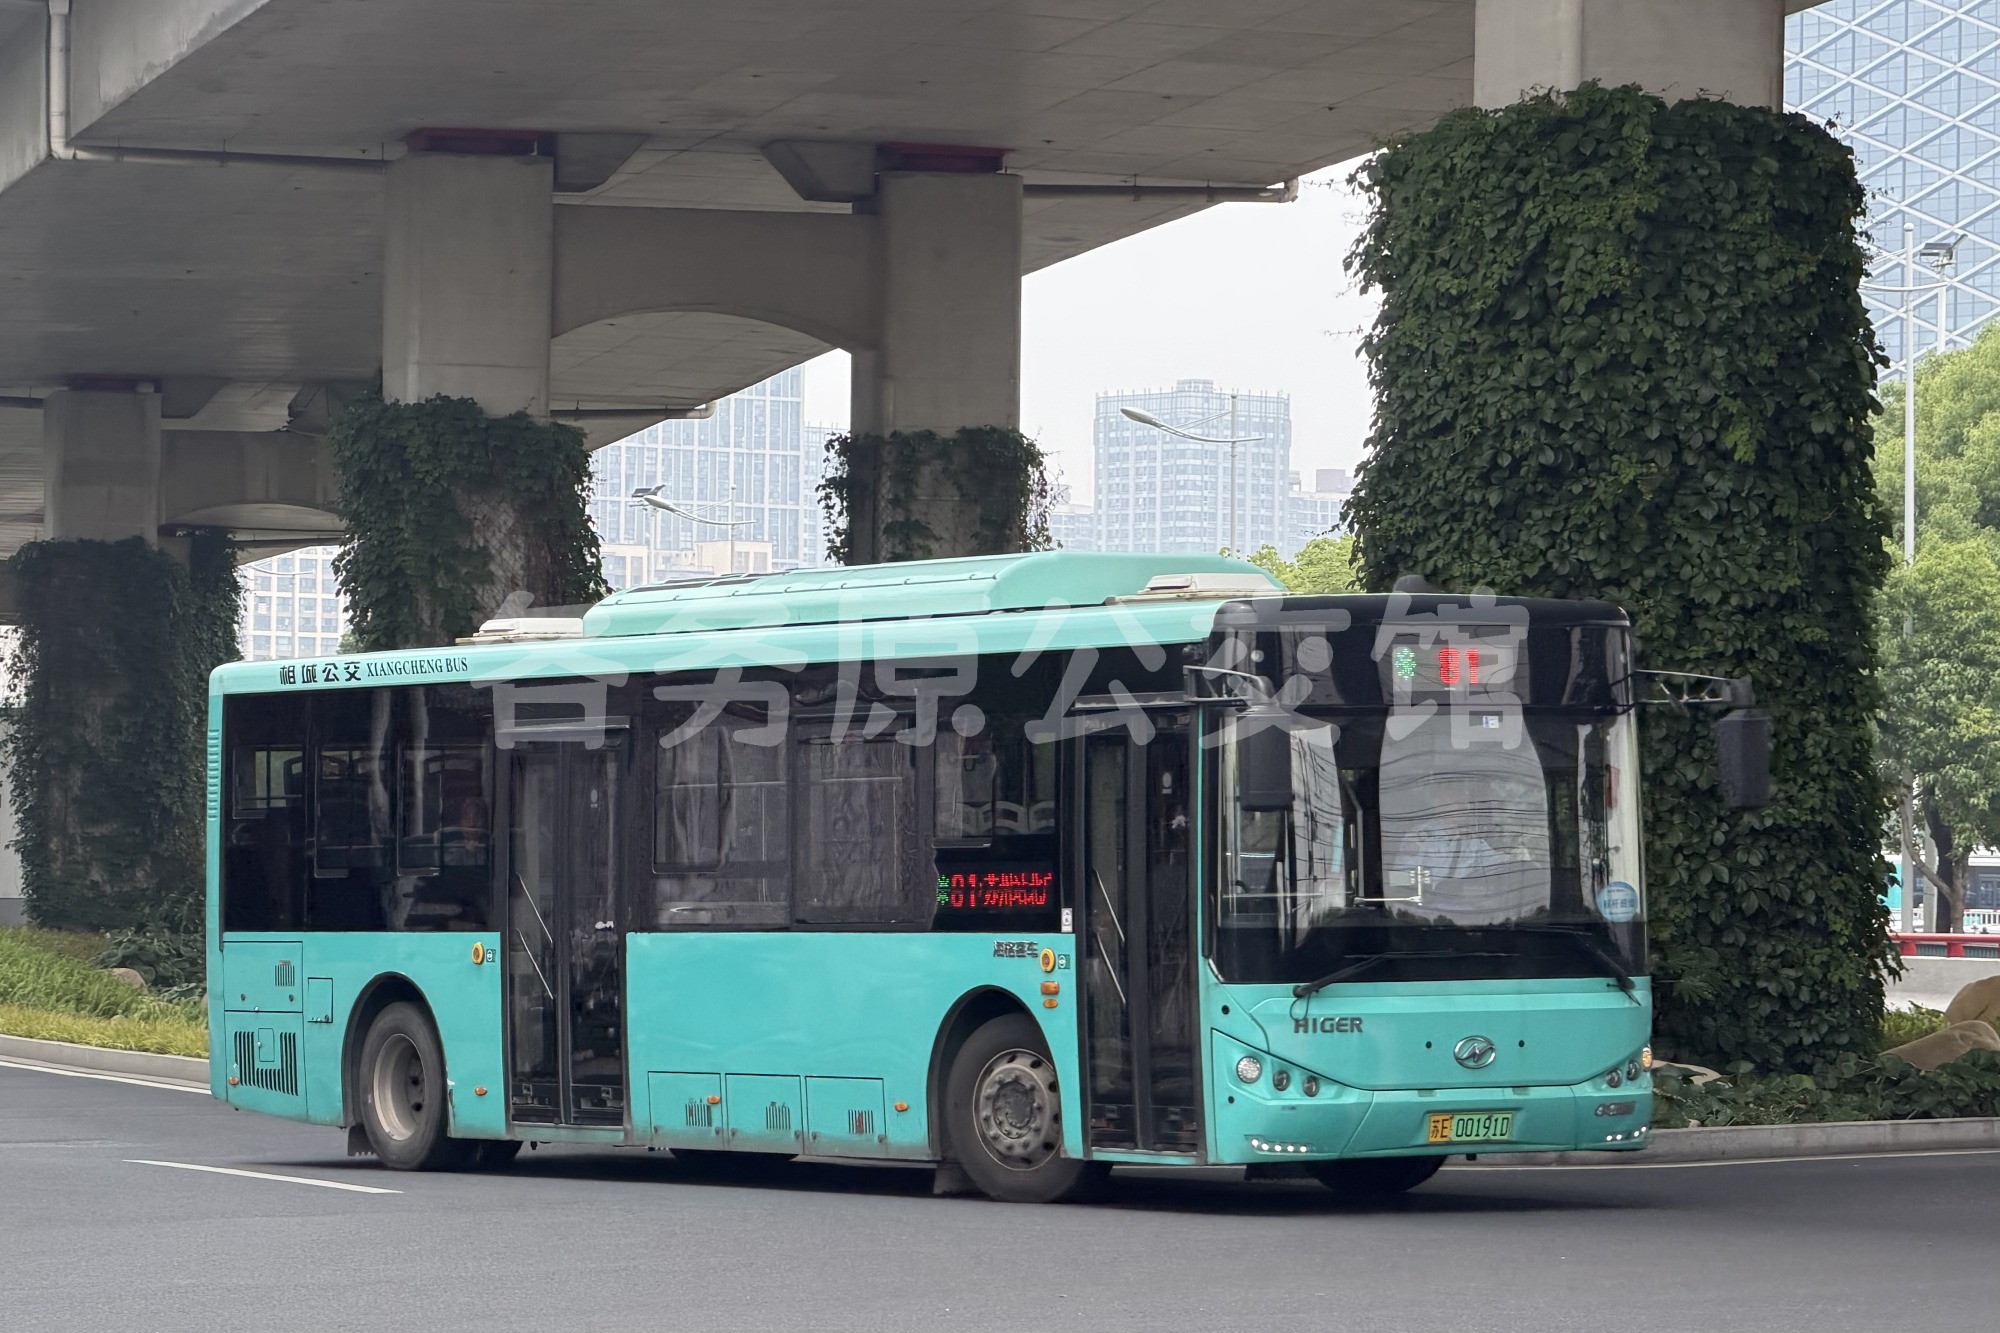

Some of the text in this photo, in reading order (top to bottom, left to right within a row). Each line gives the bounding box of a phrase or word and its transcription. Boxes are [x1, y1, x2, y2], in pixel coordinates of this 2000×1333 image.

[279, 660, 362, 686] 相城公交
[366, 657, 468, 677] XIANGCHENG BUS
[1438, 647, 1480, 686] 81
[1294, 1017, 1363, 1034] HIGER
[1455, 1117, 1509, 1138] 00191D
